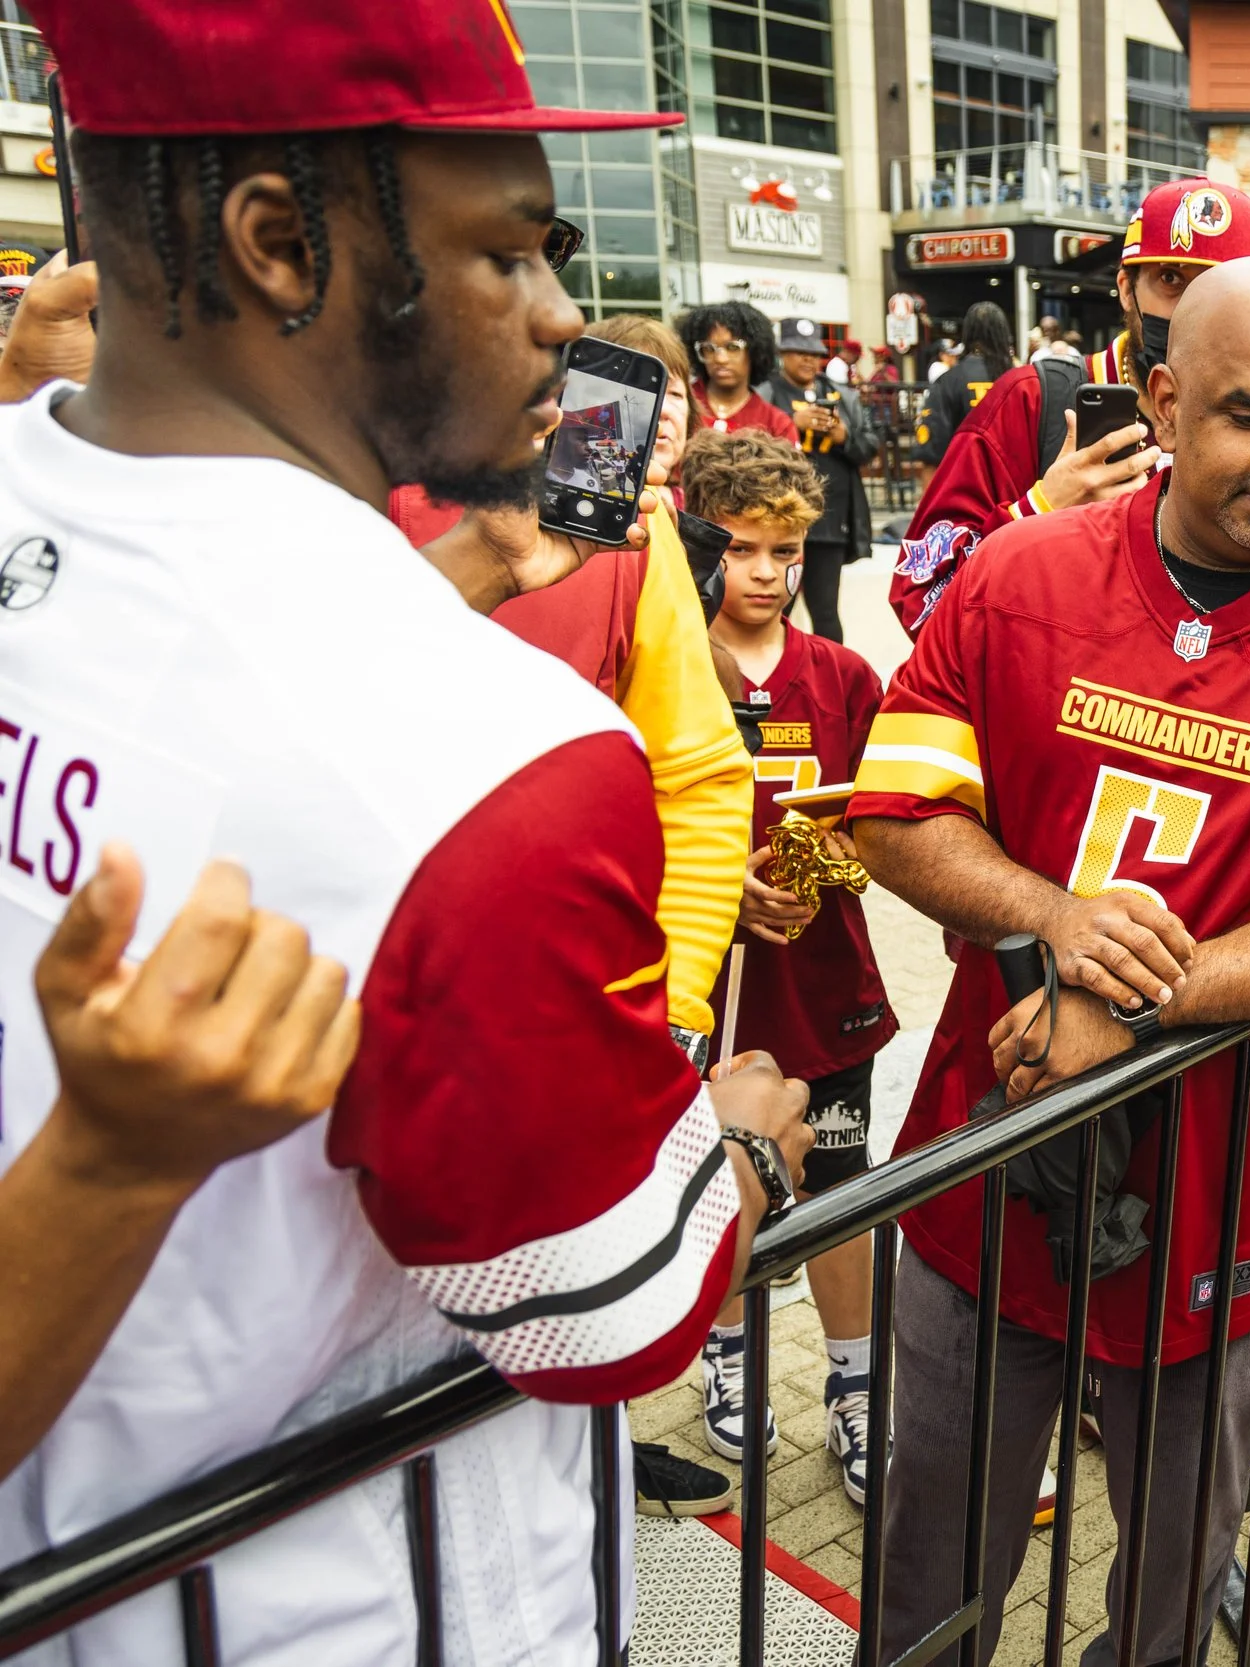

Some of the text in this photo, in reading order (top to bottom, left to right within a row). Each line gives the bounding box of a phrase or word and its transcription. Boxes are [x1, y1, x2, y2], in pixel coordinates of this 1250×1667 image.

[733, 207, 818, 247] MASON'S
[924, 237, 1000, 259] CHIPOTLE
[1179, 635, 1202, 654] NFL
[816, 1124, 864, 1147] RTNITE
